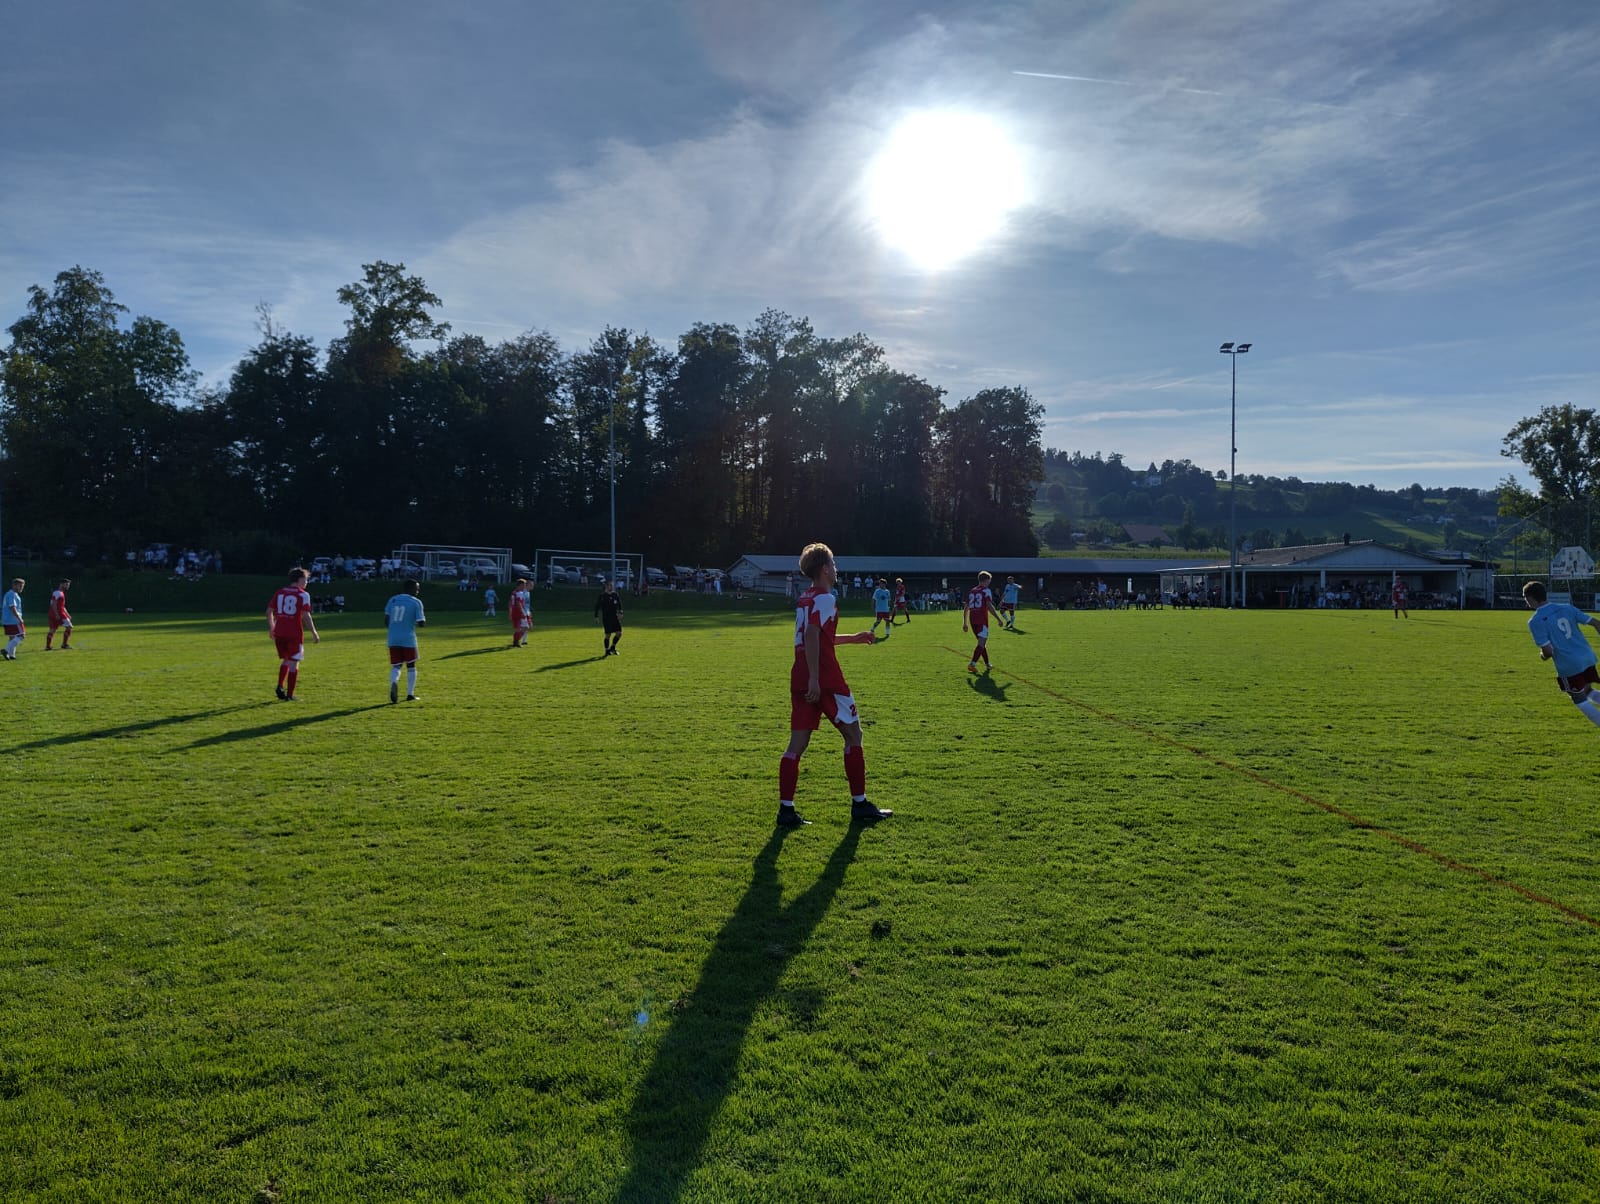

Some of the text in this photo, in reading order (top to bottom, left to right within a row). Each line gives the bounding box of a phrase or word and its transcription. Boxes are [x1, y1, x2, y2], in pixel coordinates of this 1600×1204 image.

[276, 593, 298, 616] 18
[968, 592, 983, 609] 23
[1557, 617, 1572, 640] 9
